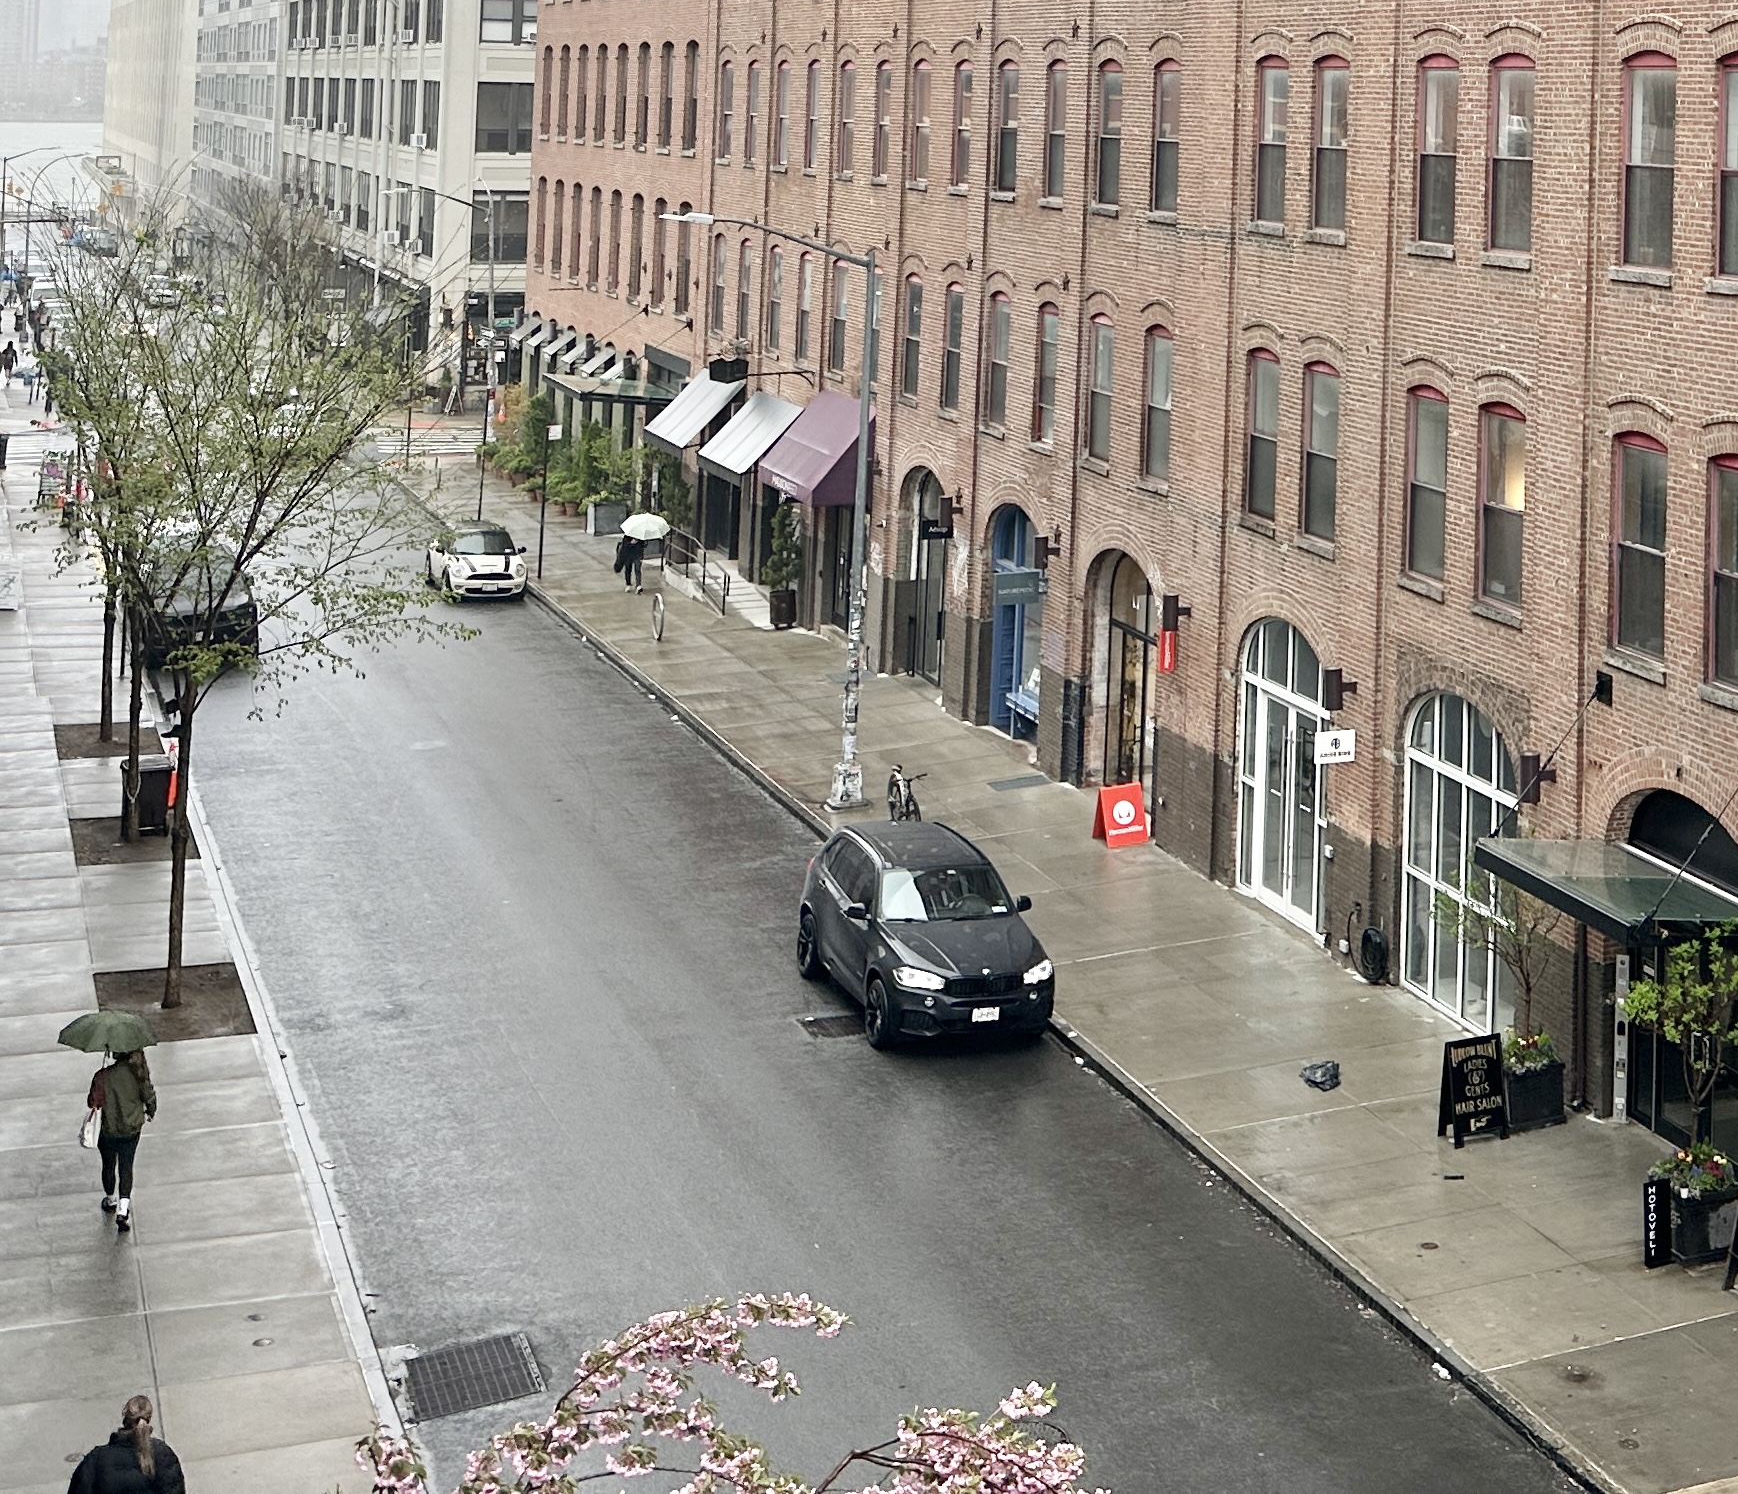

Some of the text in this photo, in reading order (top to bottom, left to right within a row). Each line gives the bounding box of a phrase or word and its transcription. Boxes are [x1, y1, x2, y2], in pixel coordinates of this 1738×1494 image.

[1463, 1058, 1488, 1073] LADIES
[1465, 1081, 1490, 1097] GENTS
[1455, 1094, 1503, 1115] HAIR SALON
[1648, 1185, 1657, 1257] HOTOVELI
